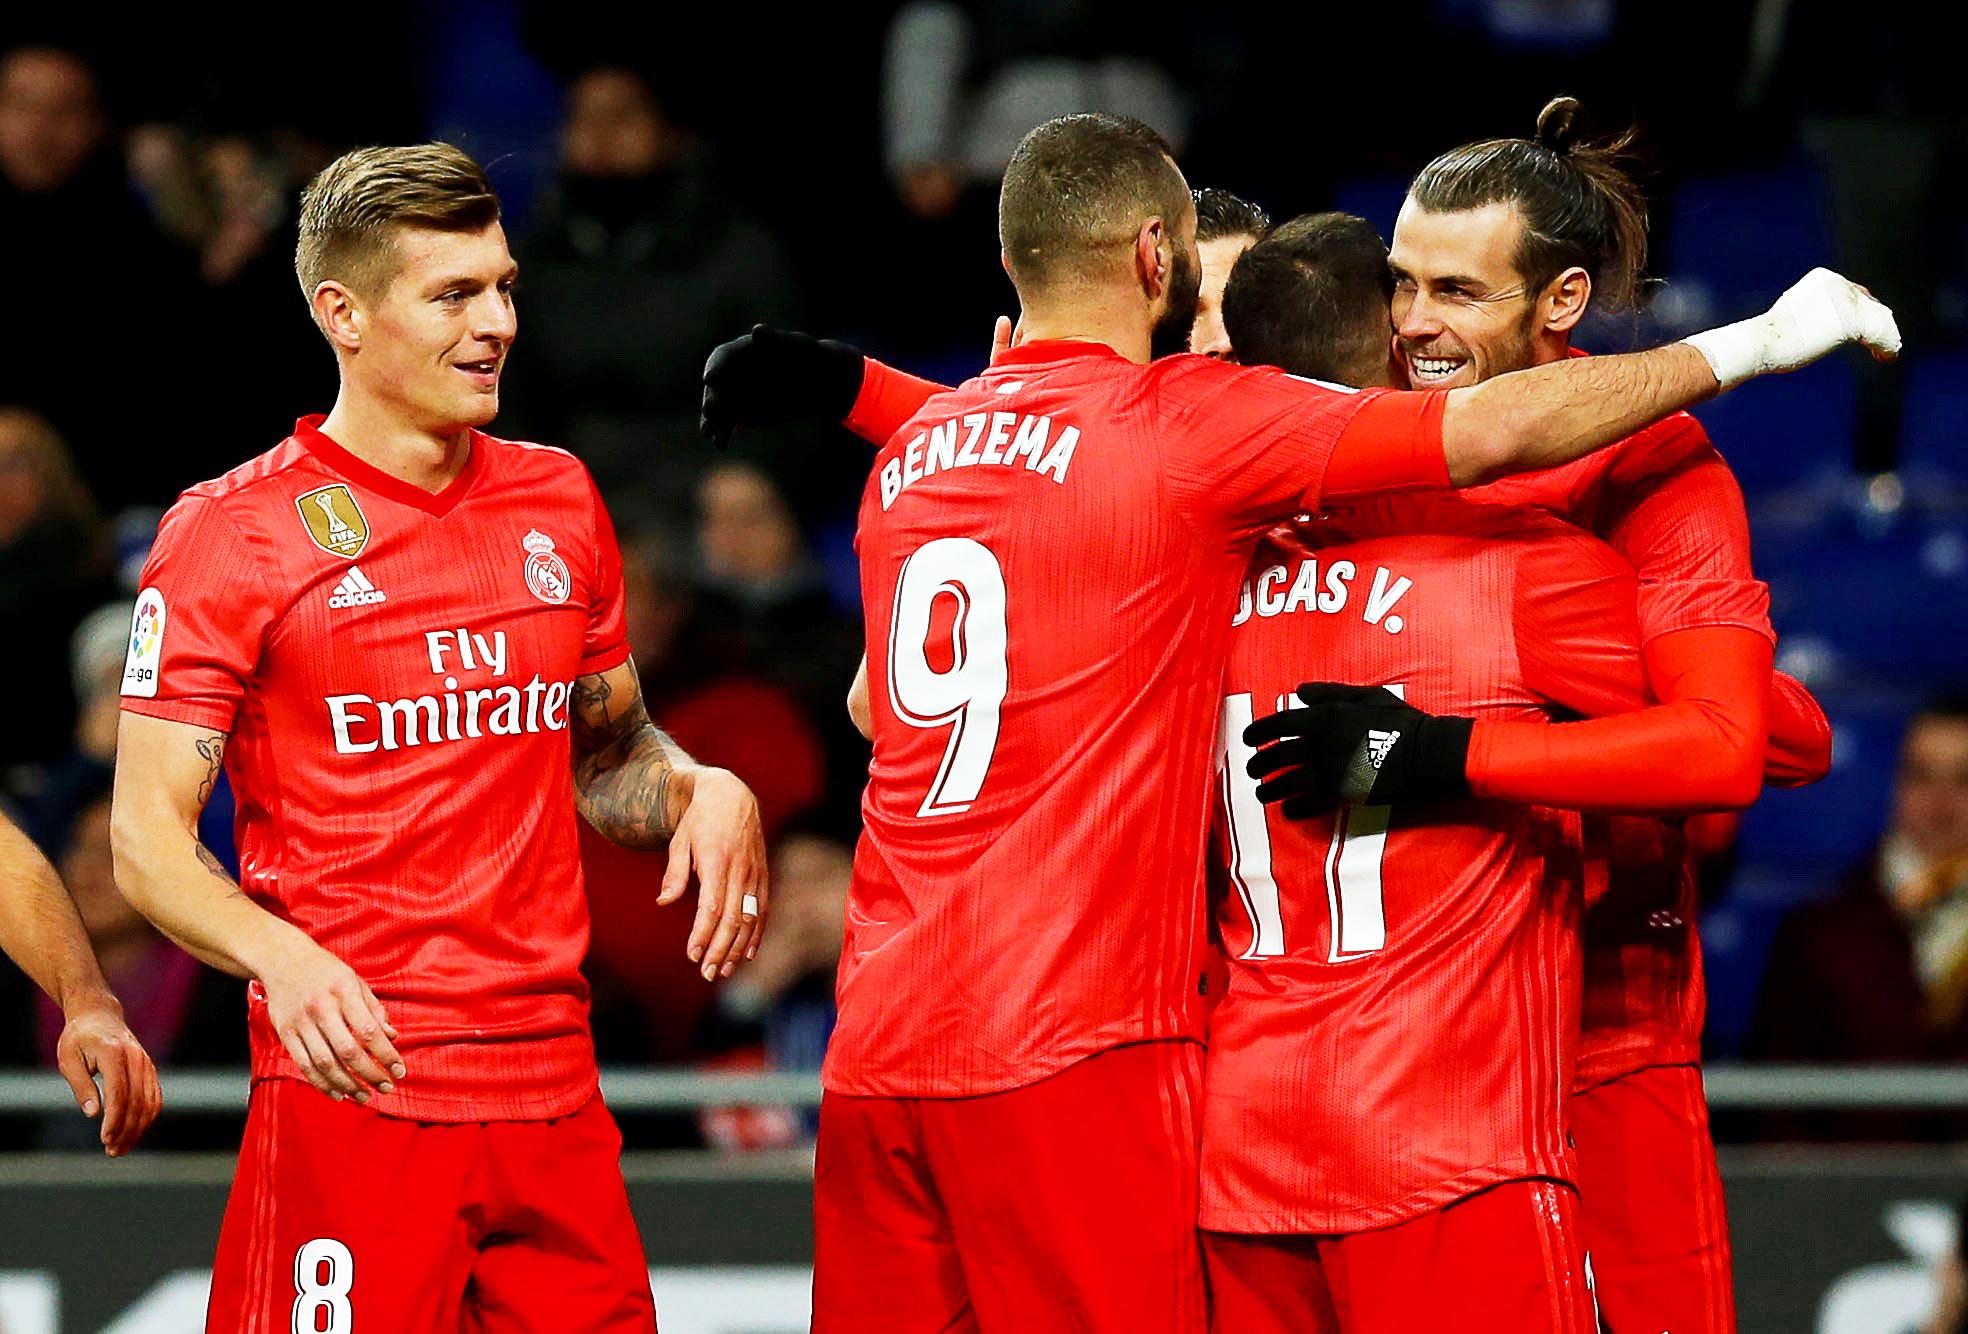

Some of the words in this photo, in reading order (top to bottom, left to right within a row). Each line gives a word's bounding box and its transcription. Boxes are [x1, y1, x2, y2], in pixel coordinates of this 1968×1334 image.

[880, 411, 1081, 512] BENZEMA
[328, 590, 387, 609] adidas
[1362, 566, 1413, 634] V.
[425, 628, 506, 676] Fly
[887, 537, 1008, 818] 9
[291, 1238, 353, 1334] 8
